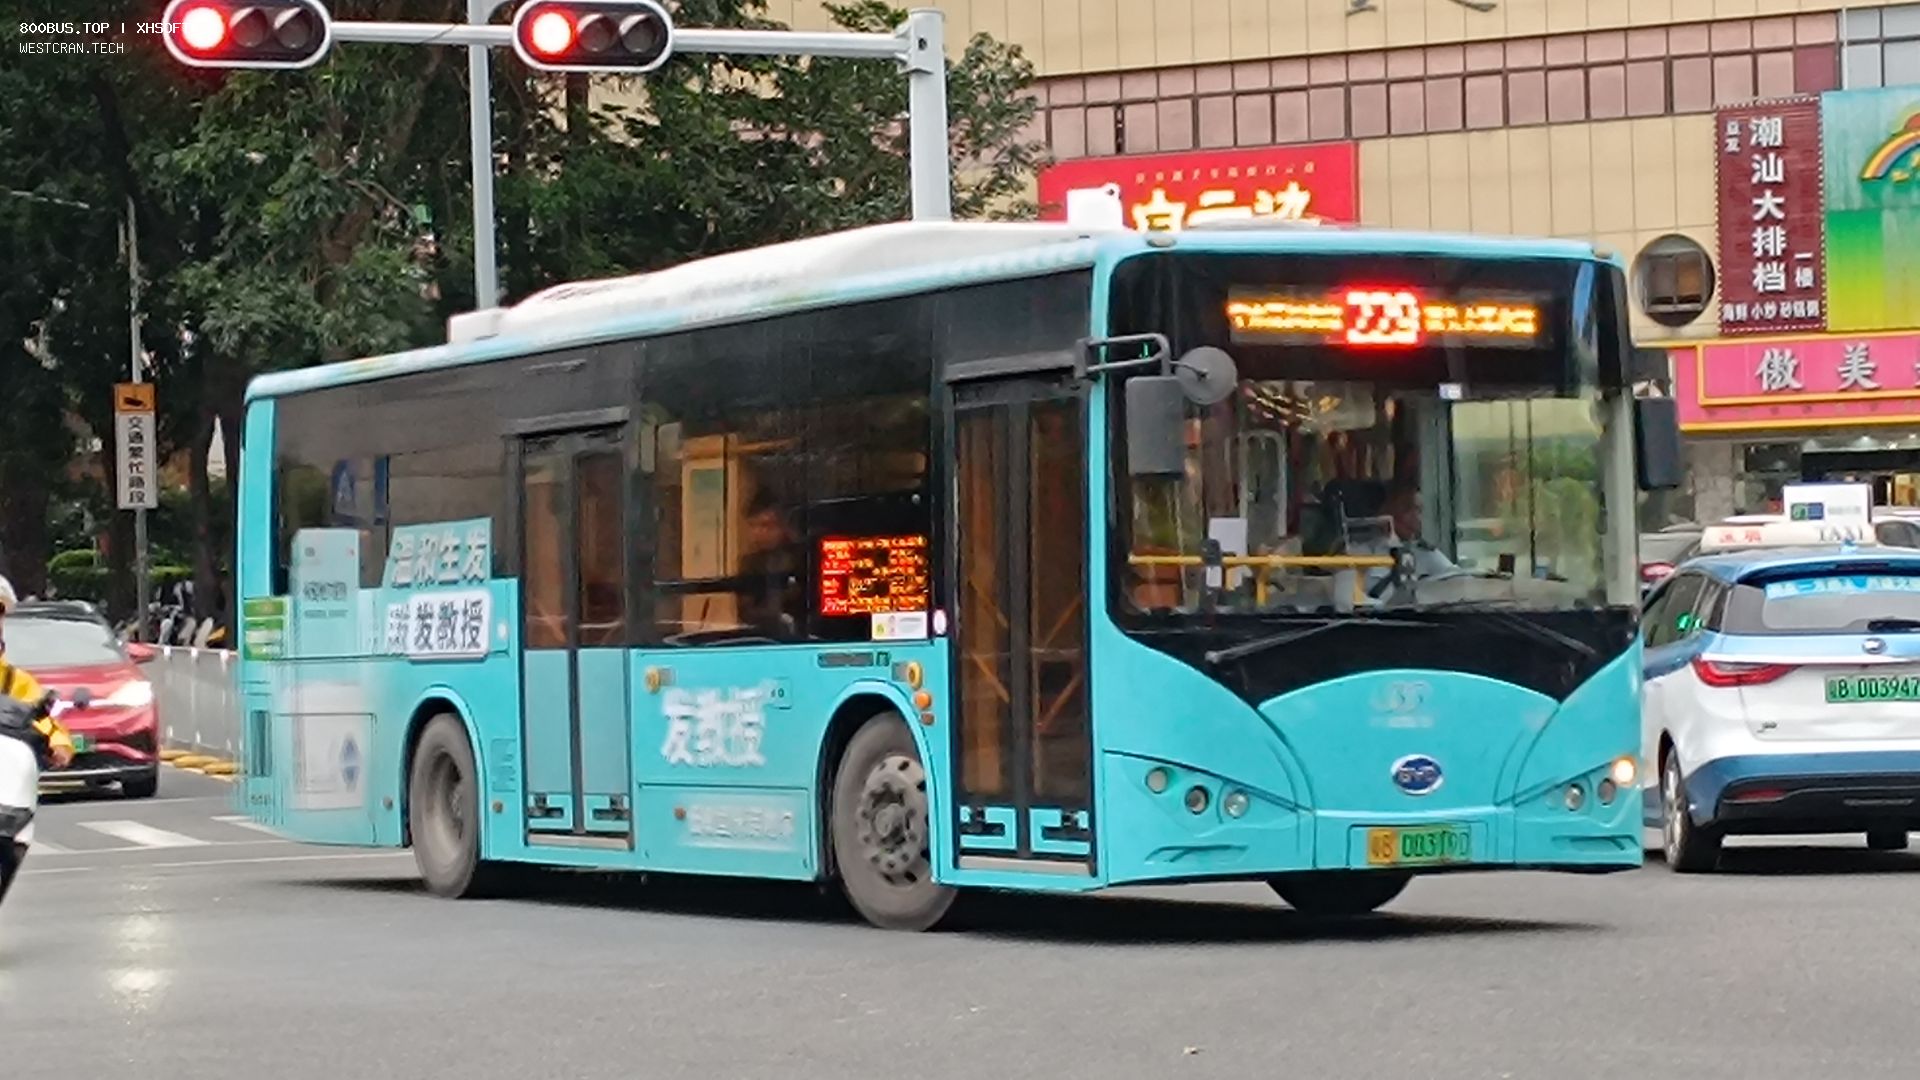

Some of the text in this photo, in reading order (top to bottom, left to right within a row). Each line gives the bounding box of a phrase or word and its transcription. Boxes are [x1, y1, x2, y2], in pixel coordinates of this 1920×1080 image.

[1750, 116, 1787, 293] 潮汕大排档
